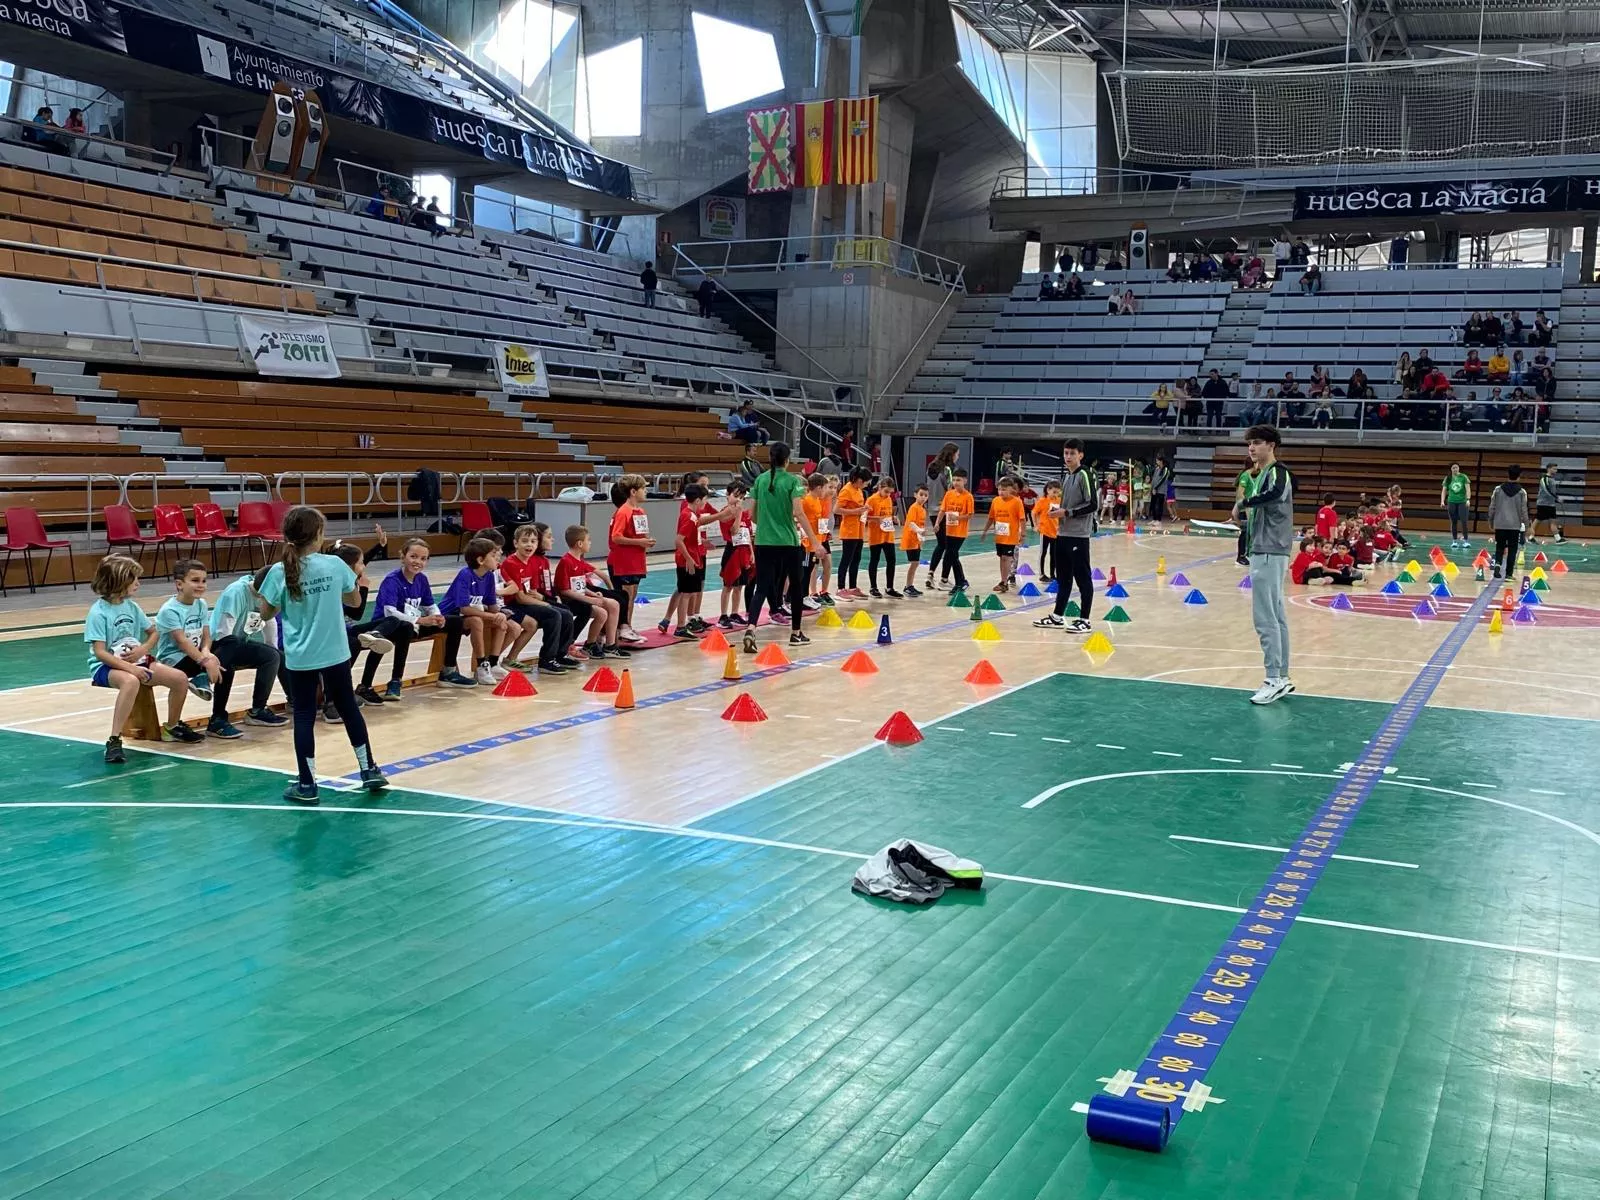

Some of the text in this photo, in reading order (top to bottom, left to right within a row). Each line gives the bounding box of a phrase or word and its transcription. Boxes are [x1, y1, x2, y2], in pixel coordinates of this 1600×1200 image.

[0, 4, 12, 20] a
[233, 46, 324, 87] Ayuntamiento
[236, 69, 305, 101] de Huca
[1306, 188, 1413, 211] Huesca
[1420, 190, 1451, 207] La
[280, 332, 326, 344] ATLETISMO
[282, 343, 329, 363] ZOITI
[1523, 582, 1529, 590] 5
[1506, 595, 1512, 604] 6
[881, 626, 888, 637] 3
[1263, 892, 1297, 908] 28
[1212, 968, 1250, 988] 29
[1202, 989, 1235, 1004] 20
[1189, 1011, 1221, 1025] 40
[1174, 1032, 1208, 1048] 60
[1157, 1056, 1193, 1073] 80
[1136, 1076, 1186, 1103] 30
